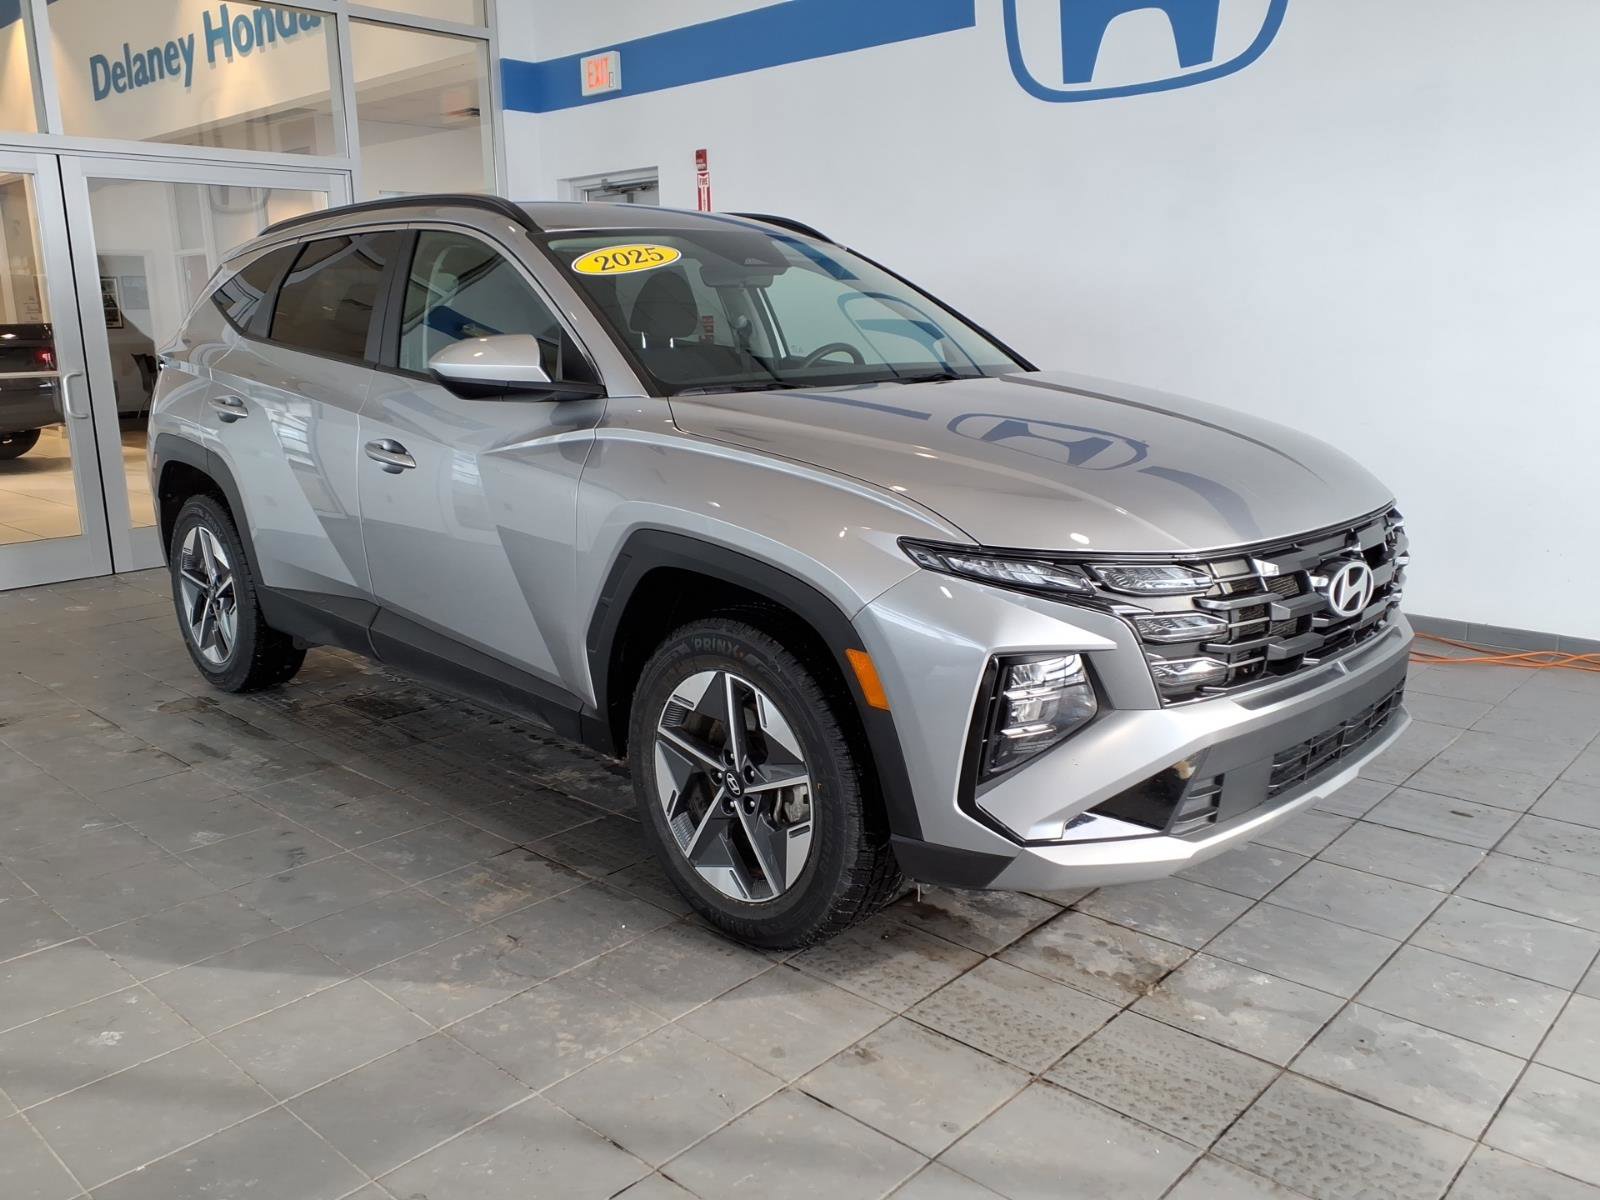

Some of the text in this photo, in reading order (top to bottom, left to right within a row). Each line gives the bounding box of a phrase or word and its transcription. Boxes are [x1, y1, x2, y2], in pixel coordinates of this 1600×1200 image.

[89, 33, 194, 101] Delaney
[586, 57, 608, 88] EXIT
[594, 247, 664, 271] 2025
